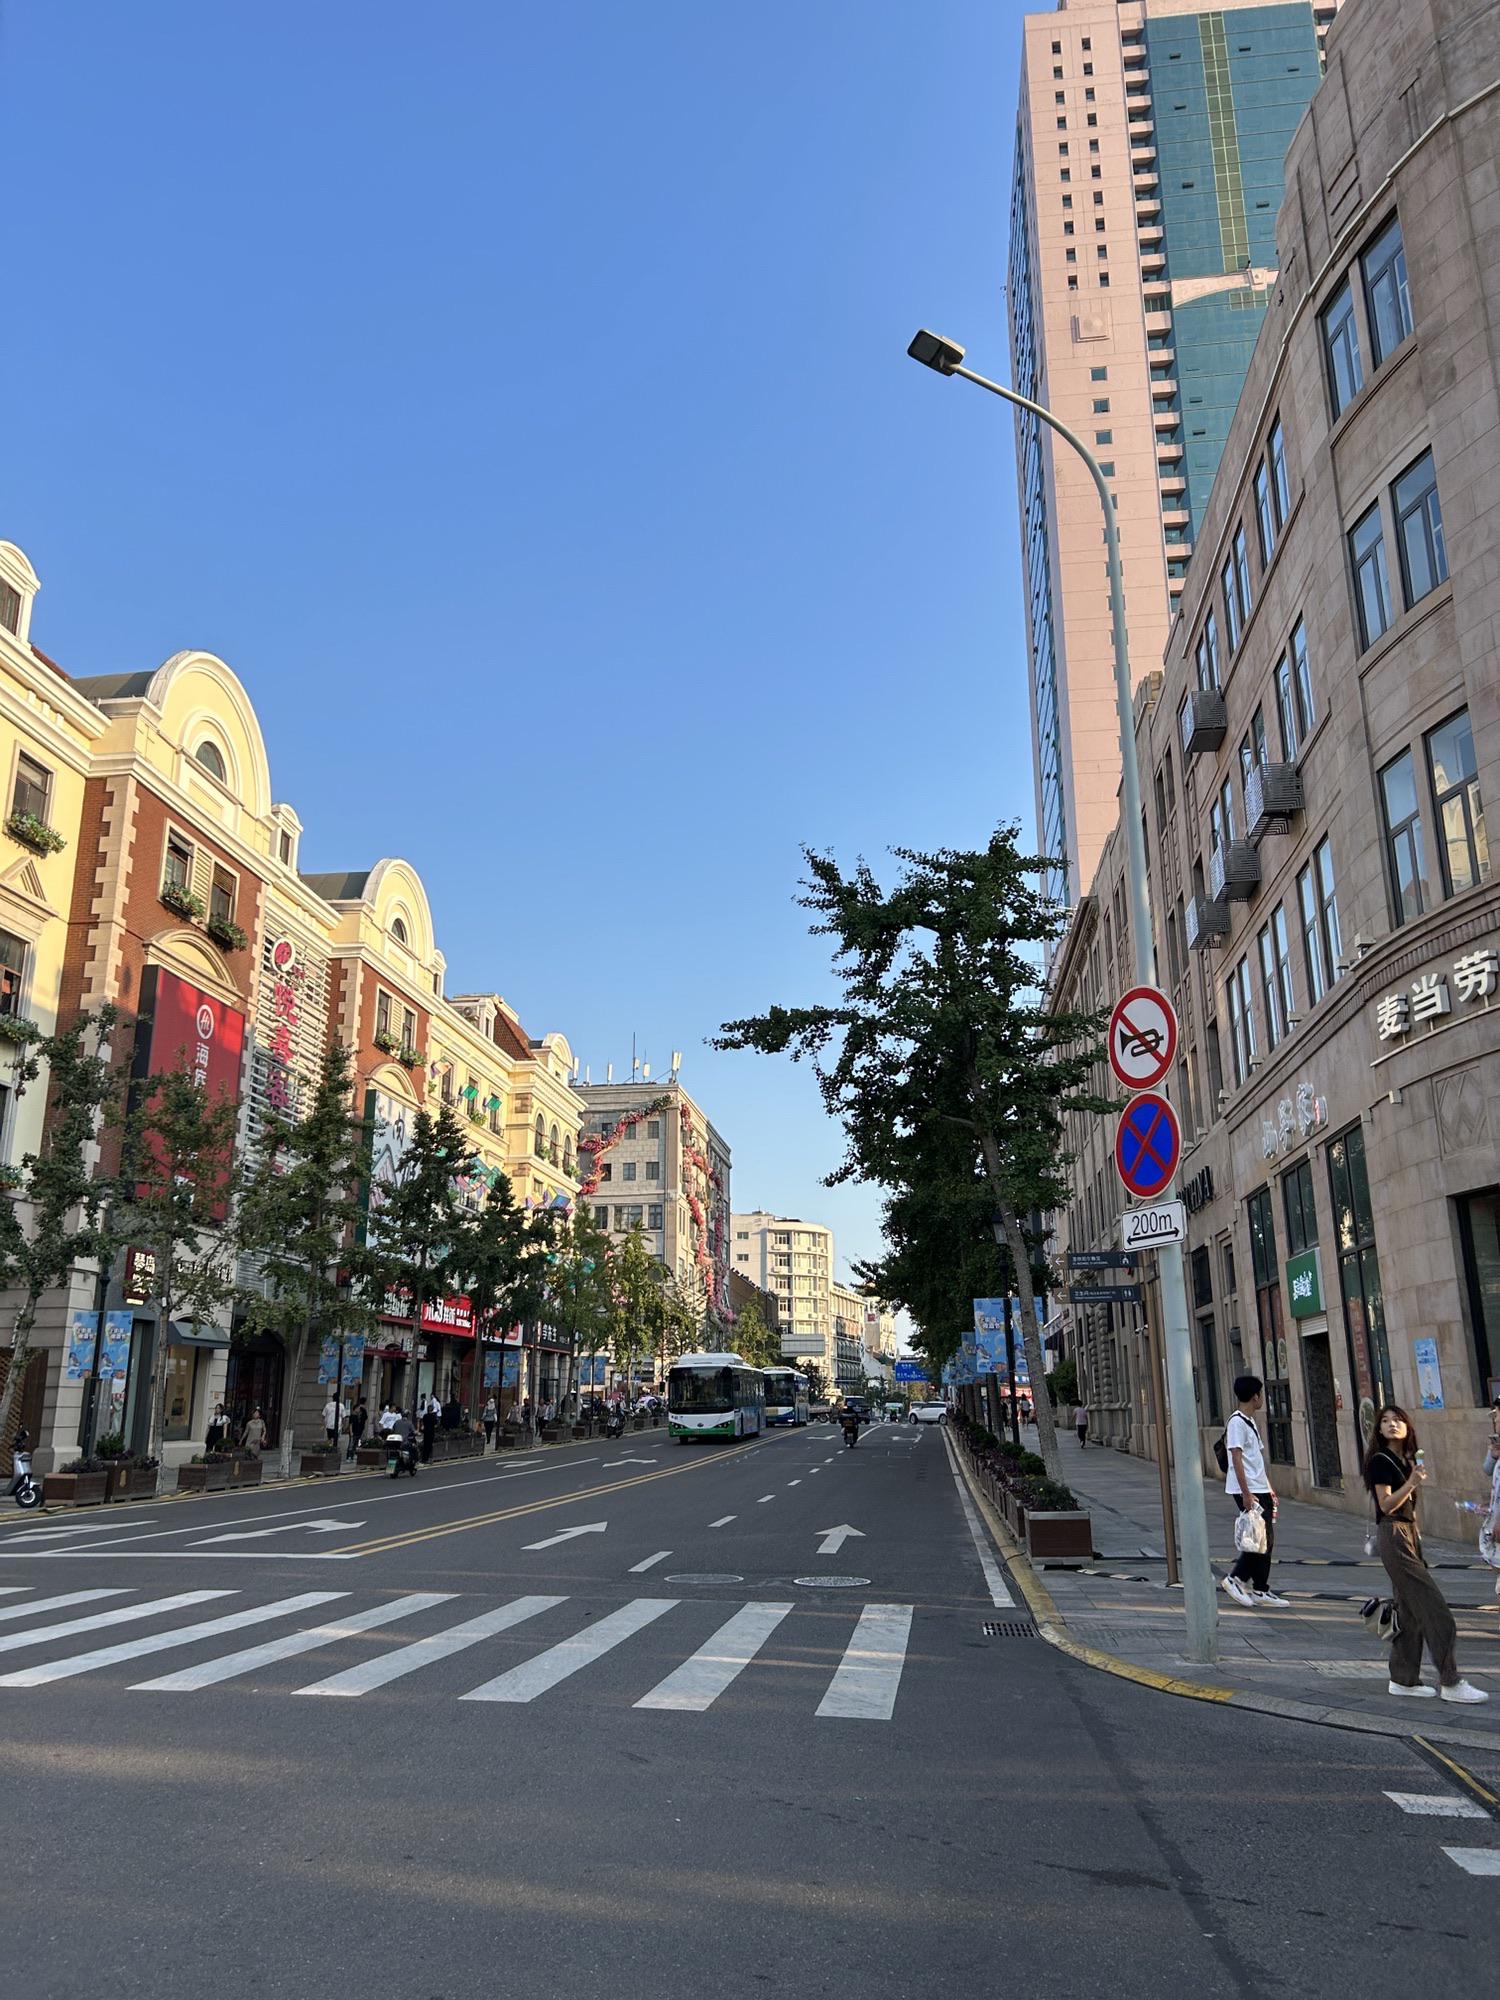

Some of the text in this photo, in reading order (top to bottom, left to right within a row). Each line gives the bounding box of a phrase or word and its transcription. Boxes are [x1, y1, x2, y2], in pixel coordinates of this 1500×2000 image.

[1376, 949, 1499, 1041] 麦当劳
[1131, 1211, 1173, 1237] 200m
